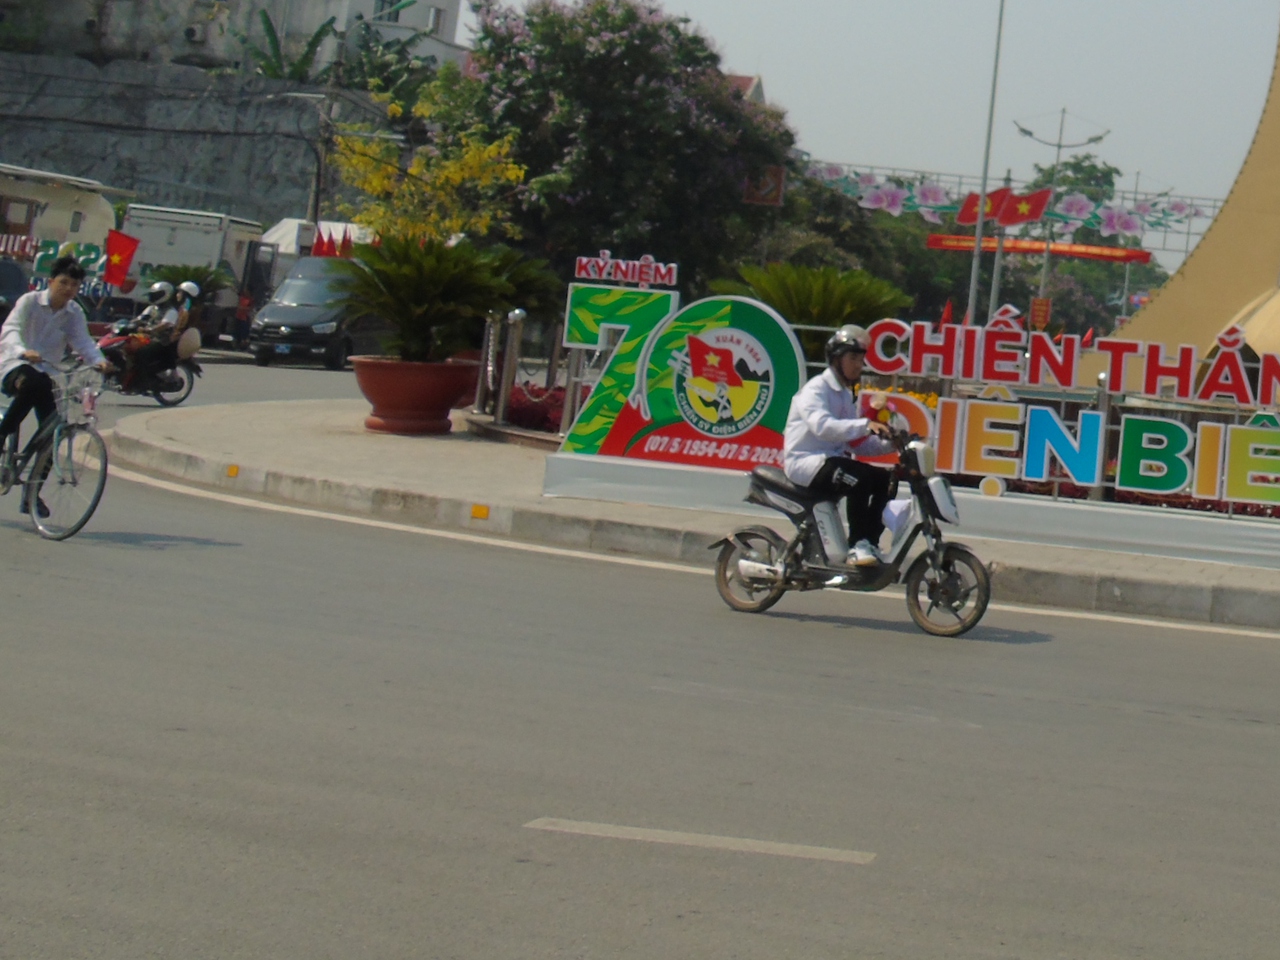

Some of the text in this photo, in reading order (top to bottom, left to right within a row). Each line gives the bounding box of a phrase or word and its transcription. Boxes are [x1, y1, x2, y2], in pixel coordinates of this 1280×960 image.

[575, 249, 678, 290] KỶ NIỆM
[558, 282, 808, 460] 70
[864, 304, 1081, 389] CHIẾN
